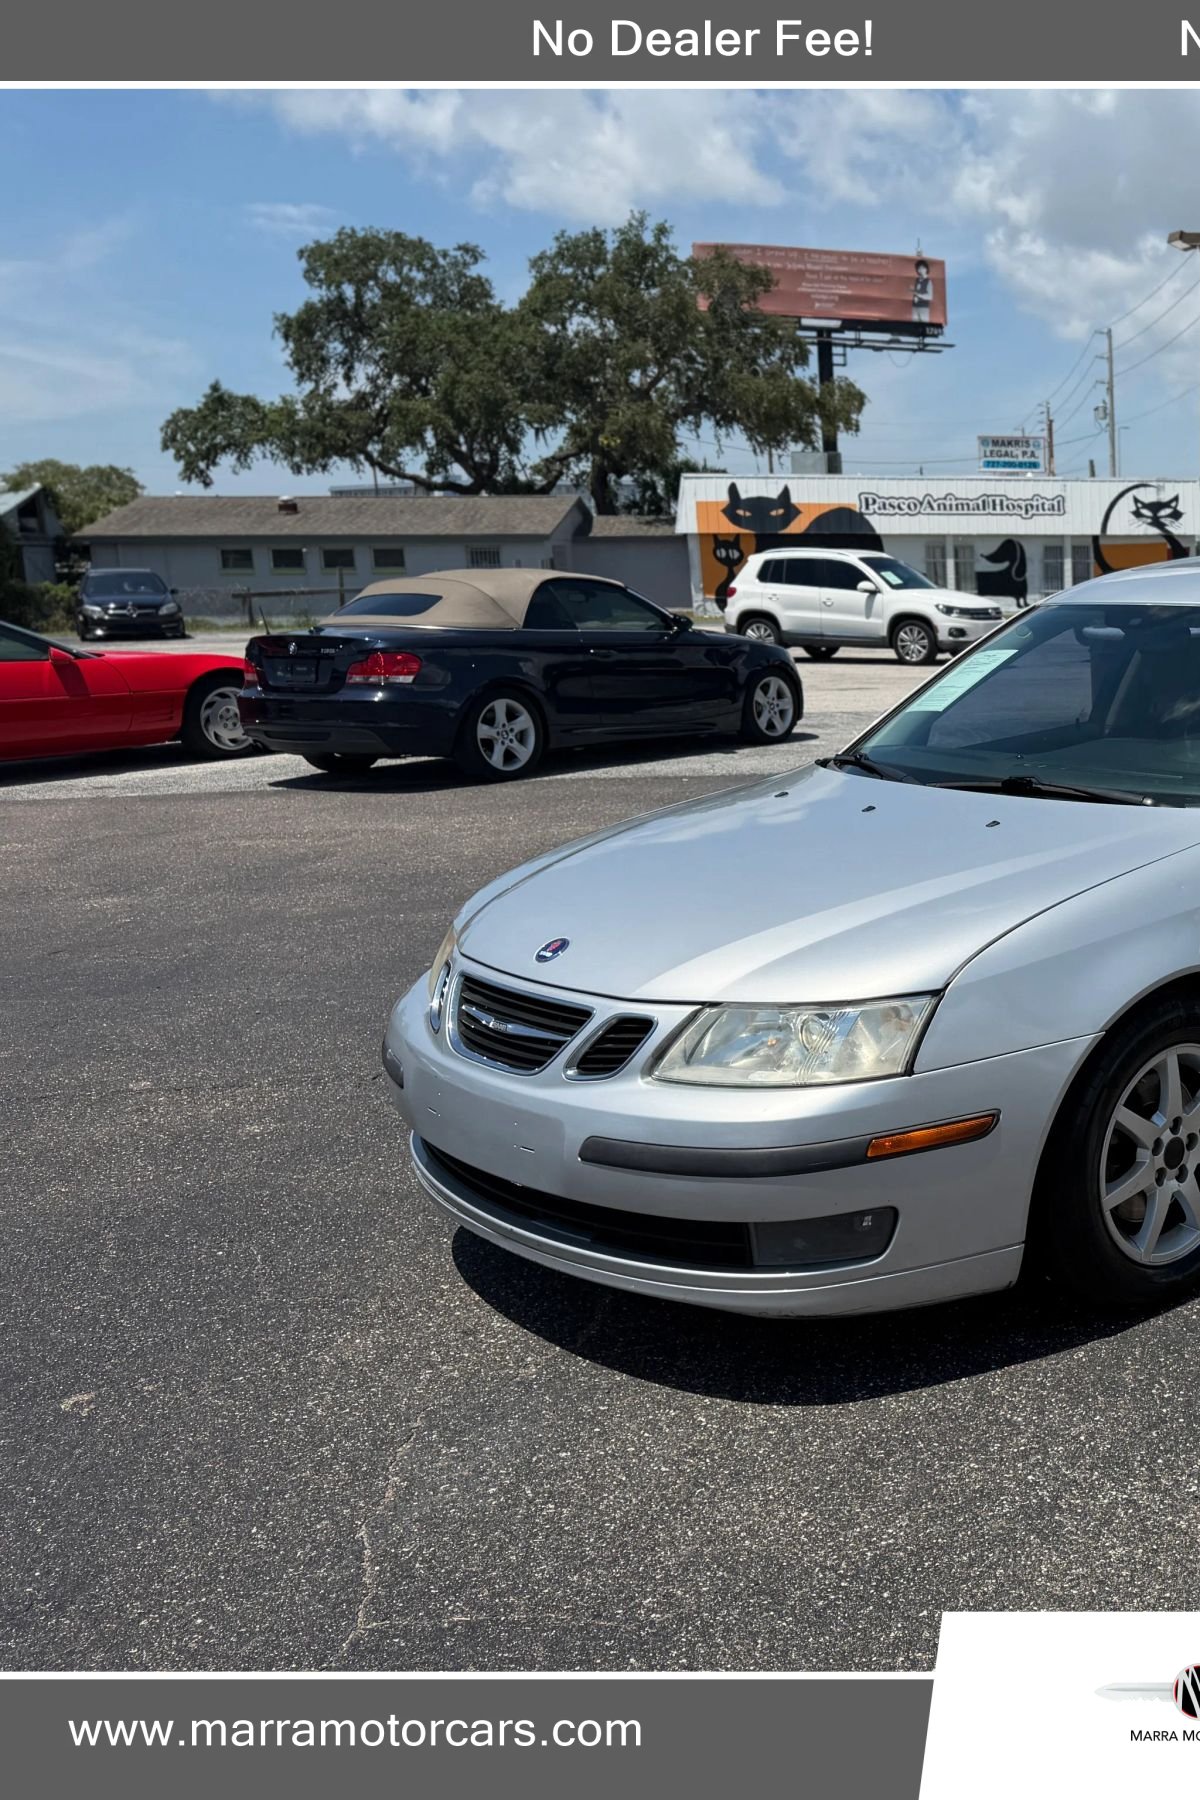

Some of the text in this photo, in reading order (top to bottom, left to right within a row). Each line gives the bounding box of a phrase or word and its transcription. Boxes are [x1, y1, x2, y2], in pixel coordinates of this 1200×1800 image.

[991, 439, 1031, 449] MAKRIS
[861, 494, 1064, 518] Pasco Animal Hospital
